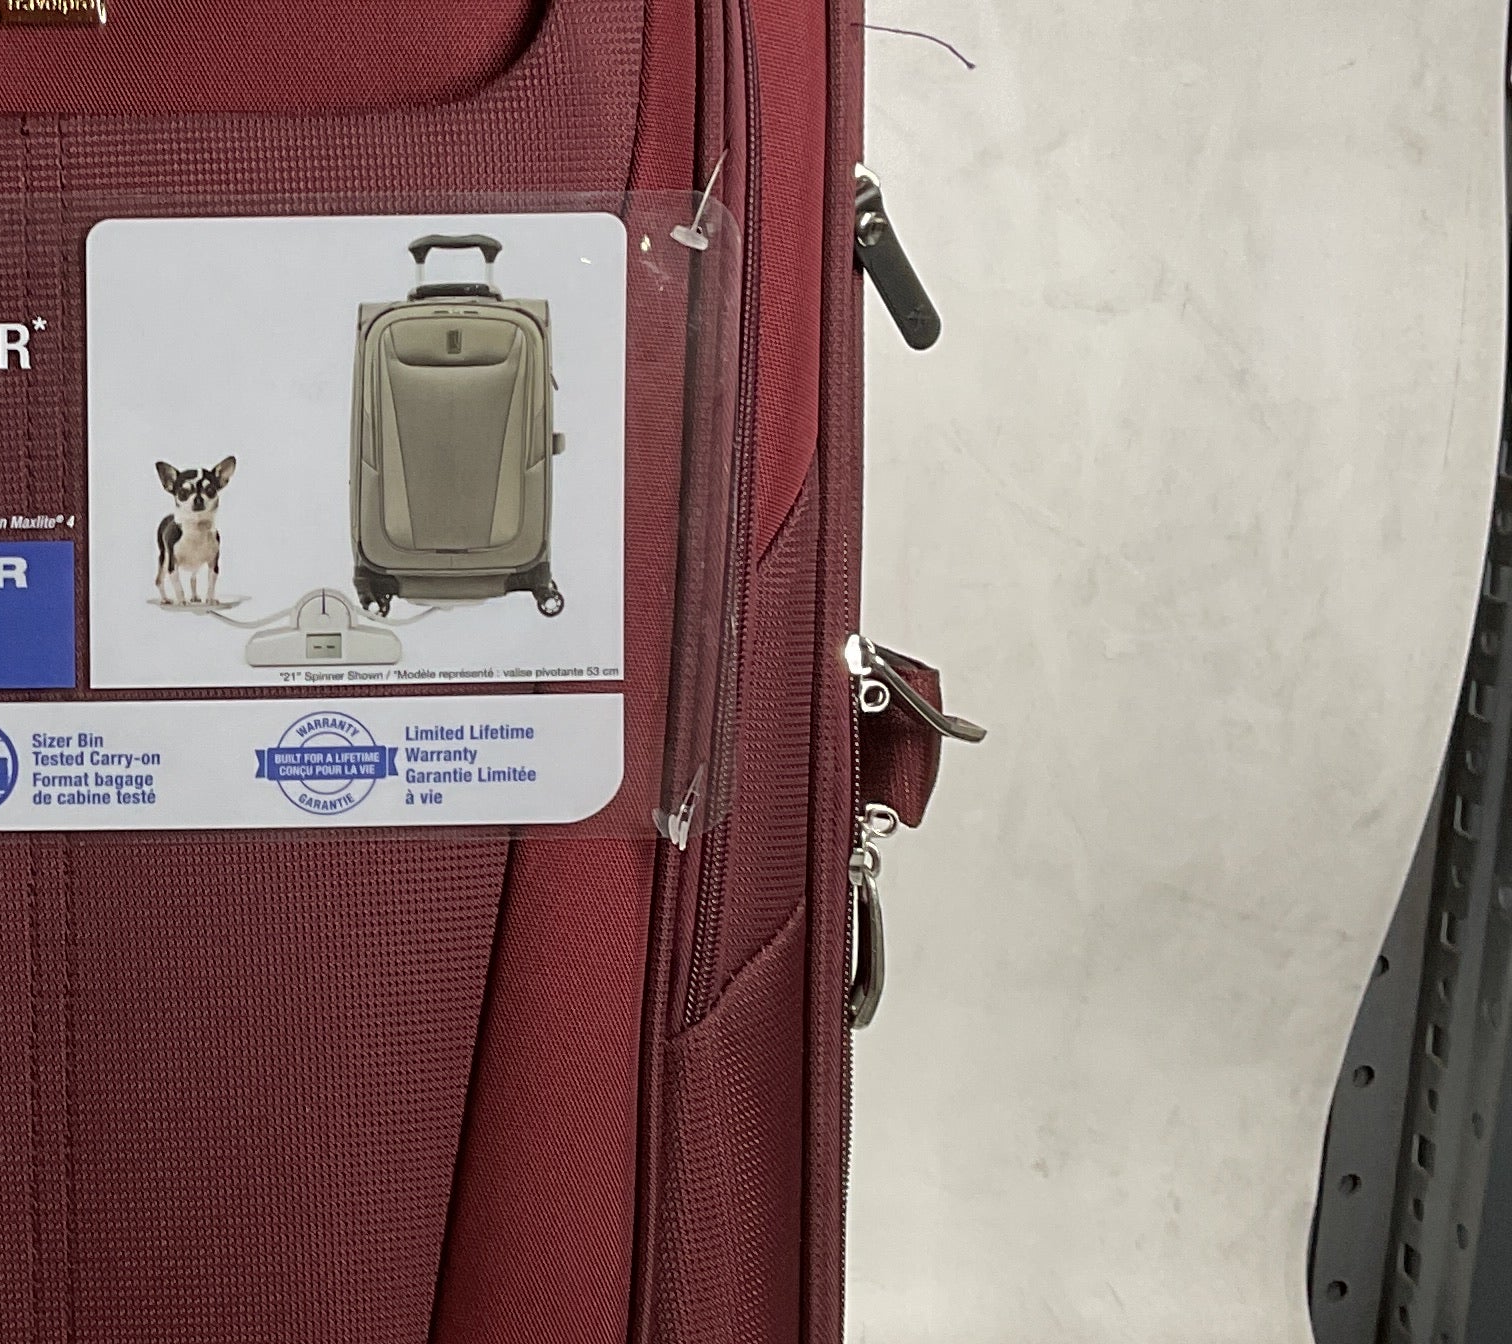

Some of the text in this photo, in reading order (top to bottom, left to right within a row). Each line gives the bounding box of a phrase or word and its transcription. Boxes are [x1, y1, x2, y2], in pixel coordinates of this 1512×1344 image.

[66, 516, 74, 528] 4
[305, 671, 344, 683] Spinner
[348, 670, 384, 681] Shown
[503, 667, 532, 678] valise
[535, 667, 584, 679] pivotante
[586, 667, 600, 676] 53
[603, 668, 618, 676] cm
[295, 718, 360, 739] WARRANTY
[405, 725, 534, 741] Limited Lifetime
[32, 733, 104, 748] Sizer Bin
[32, 750, 160, 768] Tested Carry-on
[274, 752, 380, 765] BUILT FOR A LIFETIME
[405, 748, 477, 765] Warranty
[279, 763, 375, 778] CONÇU POUR LA VIE
[405, 767, 536, 783] Garantie Limitée
[32, 771, 154, 790] Format bagage
[32, 788, 156, 805] de cabine testé
[298, 793, 355, 811] GARANTIE
[405, 790, 442, 805] à vie
